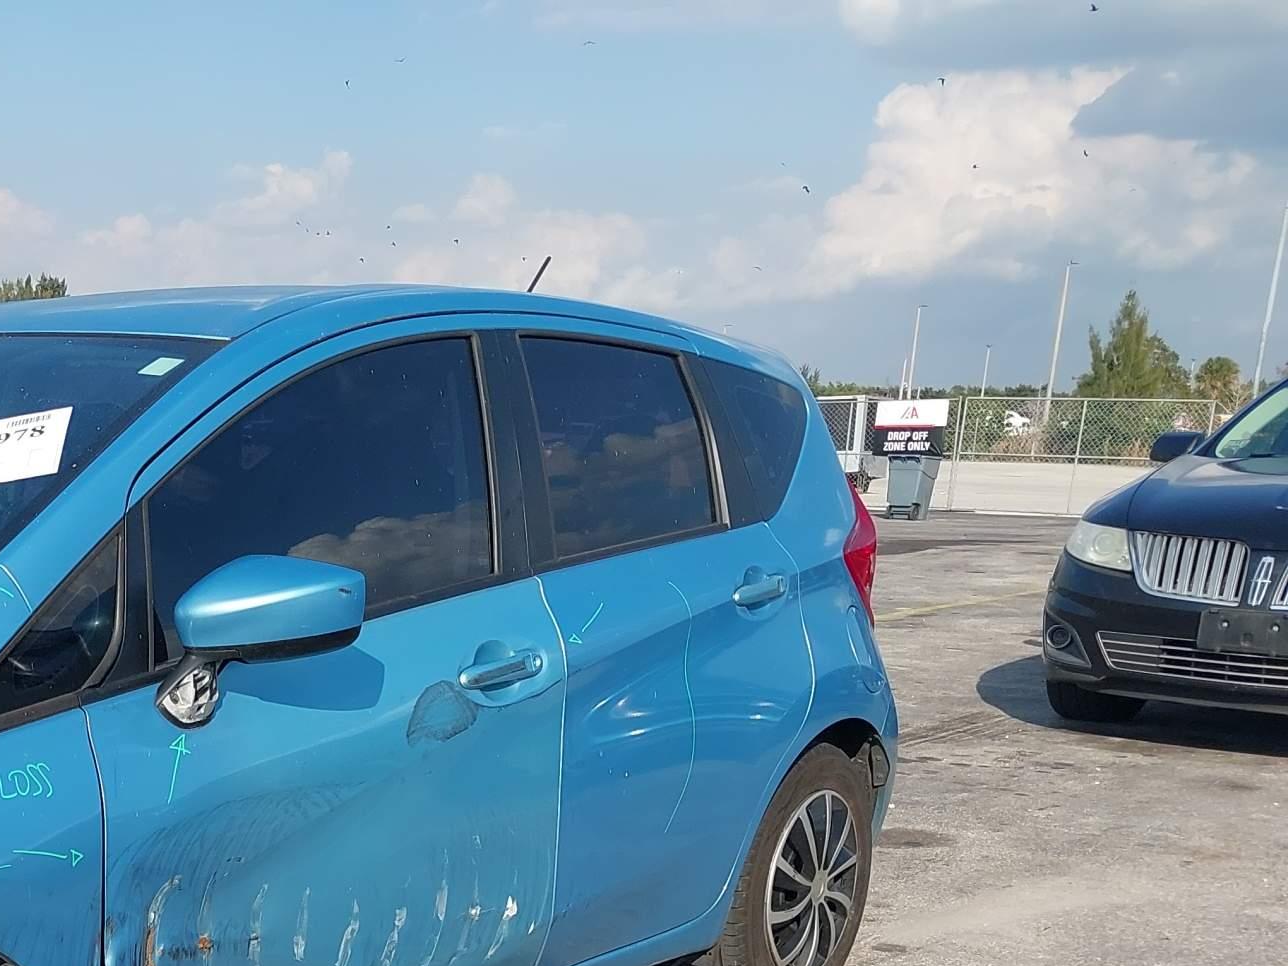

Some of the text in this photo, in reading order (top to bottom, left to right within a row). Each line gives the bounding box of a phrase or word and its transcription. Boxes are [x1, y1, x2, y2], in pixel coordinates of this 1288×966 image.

[887, 431, 929, 441] DROP OFF
[883, 441, 931, 451] ZONE ONLY
